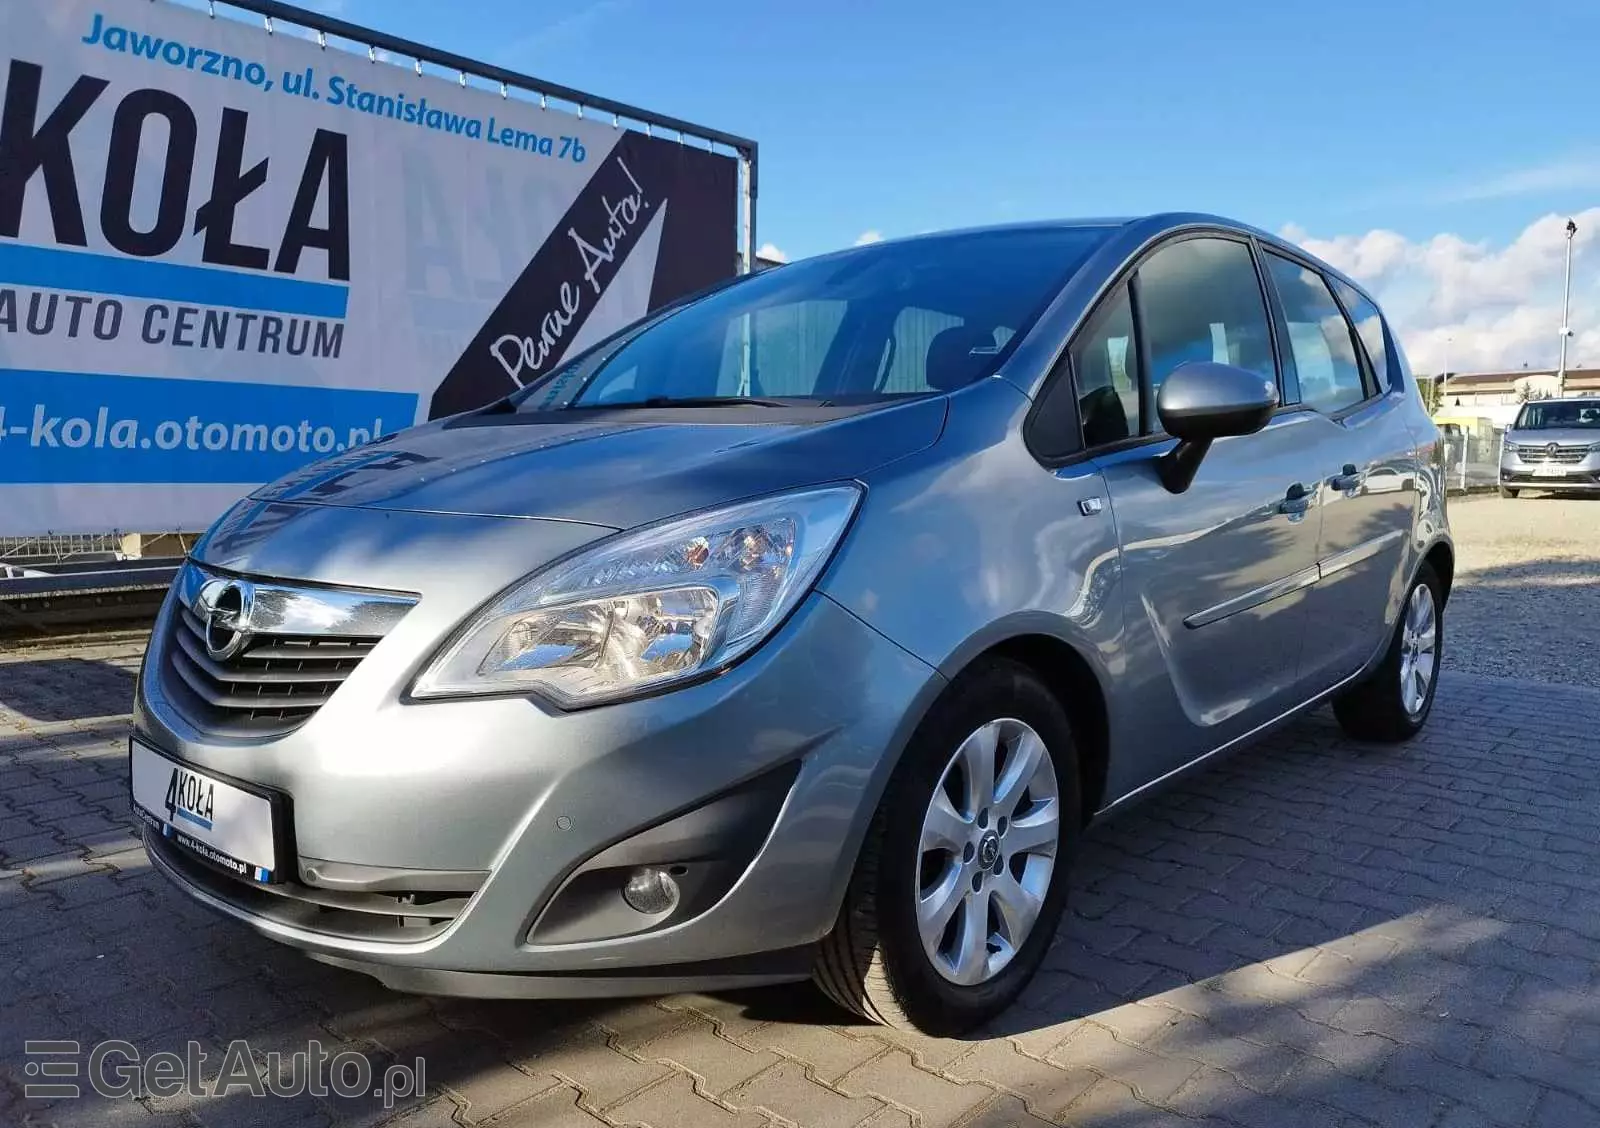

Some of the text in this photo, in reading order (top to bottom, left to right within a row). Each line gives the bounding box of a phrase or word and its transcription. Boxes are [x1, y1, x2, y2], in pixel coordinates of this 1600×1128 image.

[81, 14, 587, 163] Jaworzno, ul. Stanisława Lema 7b
[0, 58, 350, 281] KOŁA
[0, 288, 345, 359] AUTO CENTRUM
